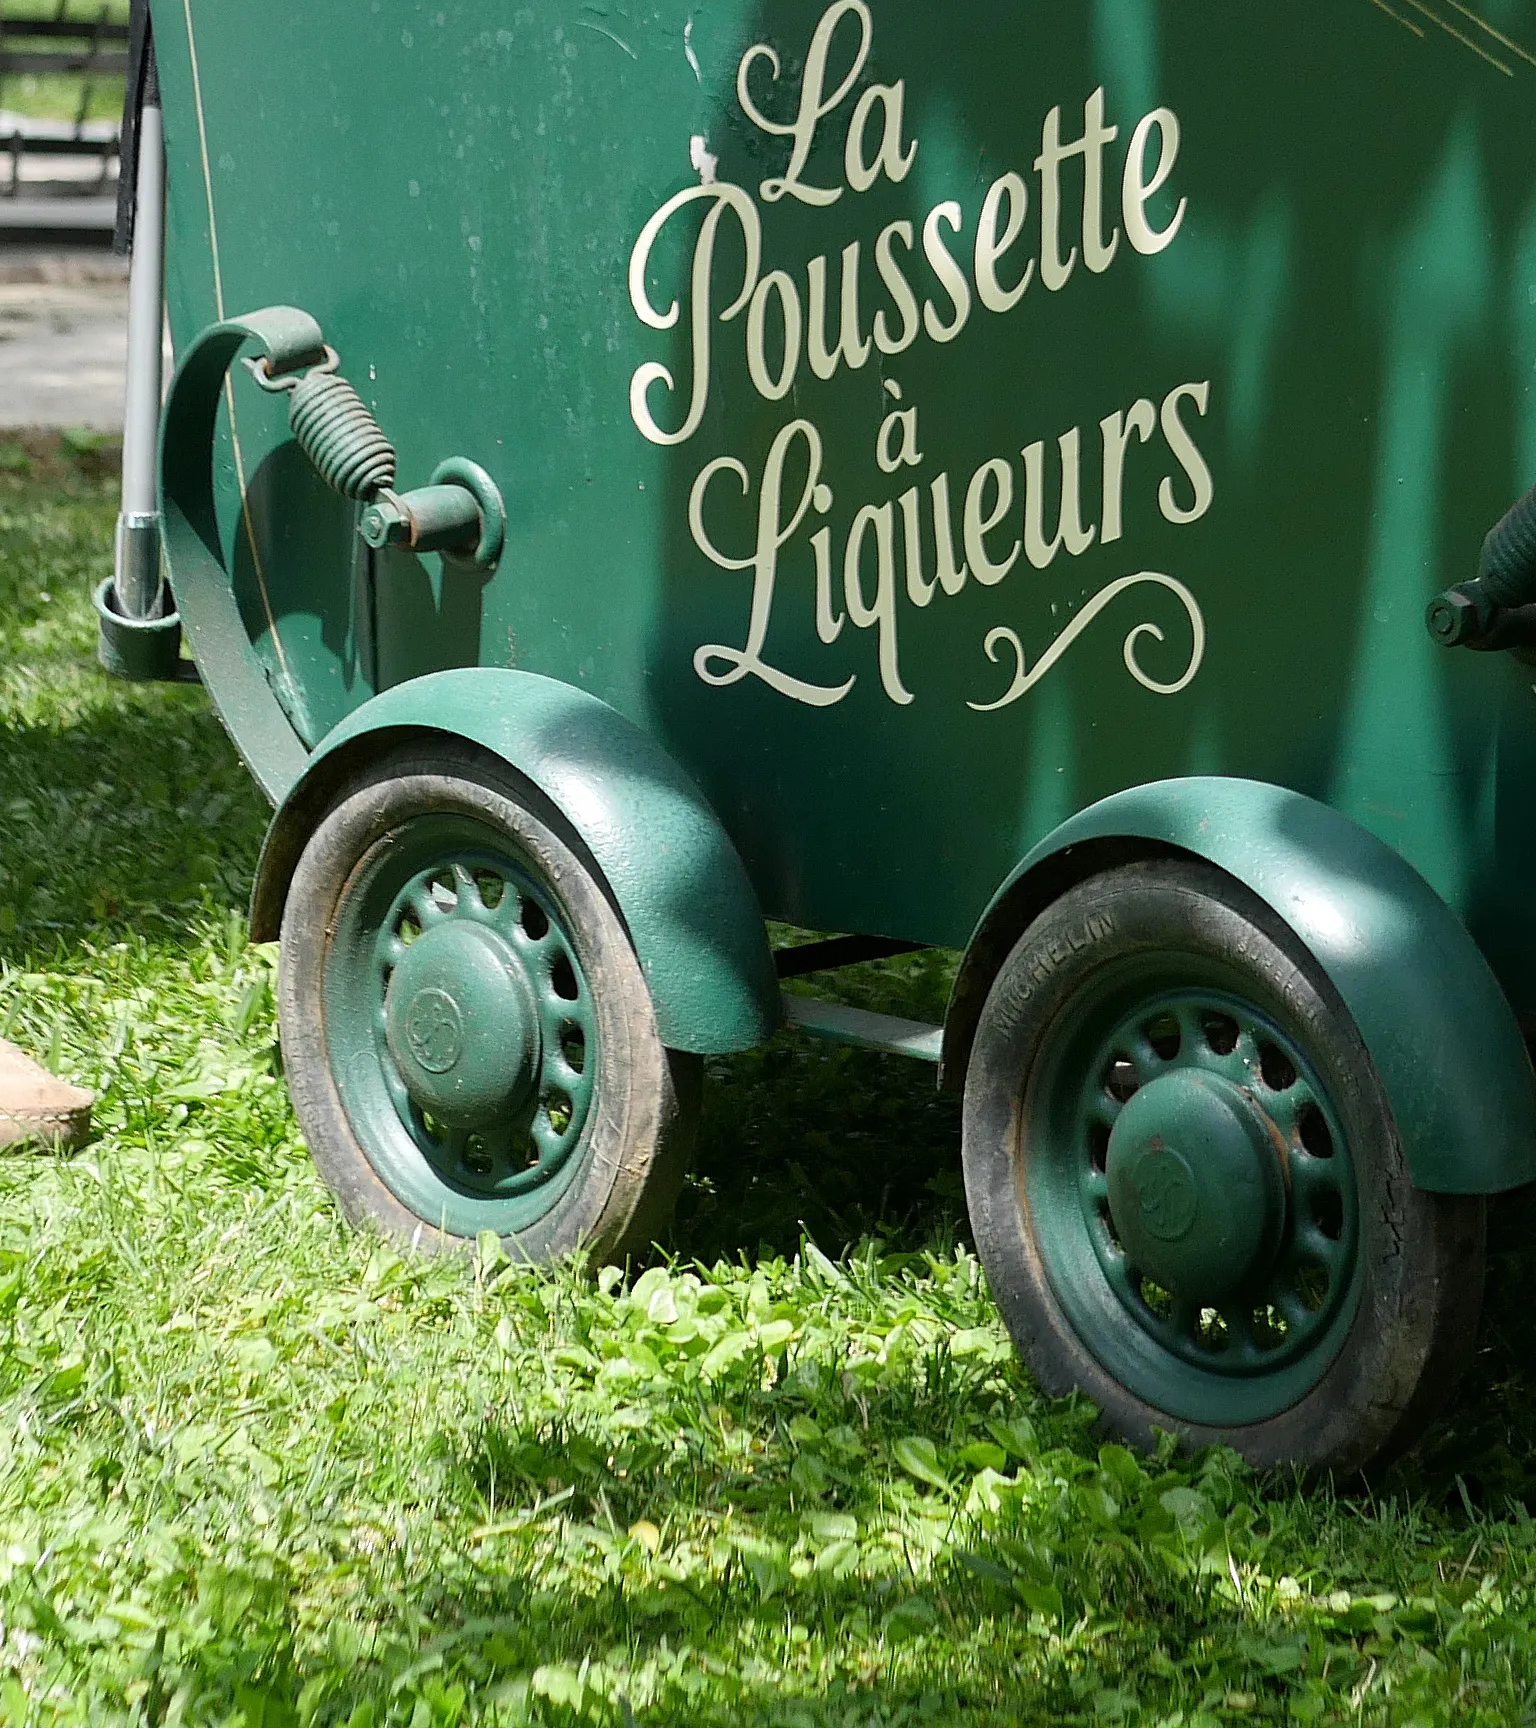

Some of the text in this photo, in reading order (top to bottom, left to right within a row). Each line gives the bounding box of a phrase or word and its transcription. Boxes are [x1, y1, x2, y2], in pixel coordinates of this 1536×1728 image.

[628, 84, 1189, 446] Poussette
[876, 377, 924, 474] à
[688, 379, 1215, 708] Liqueurs
[994, 907, 1117, 1041] MICHELIN
